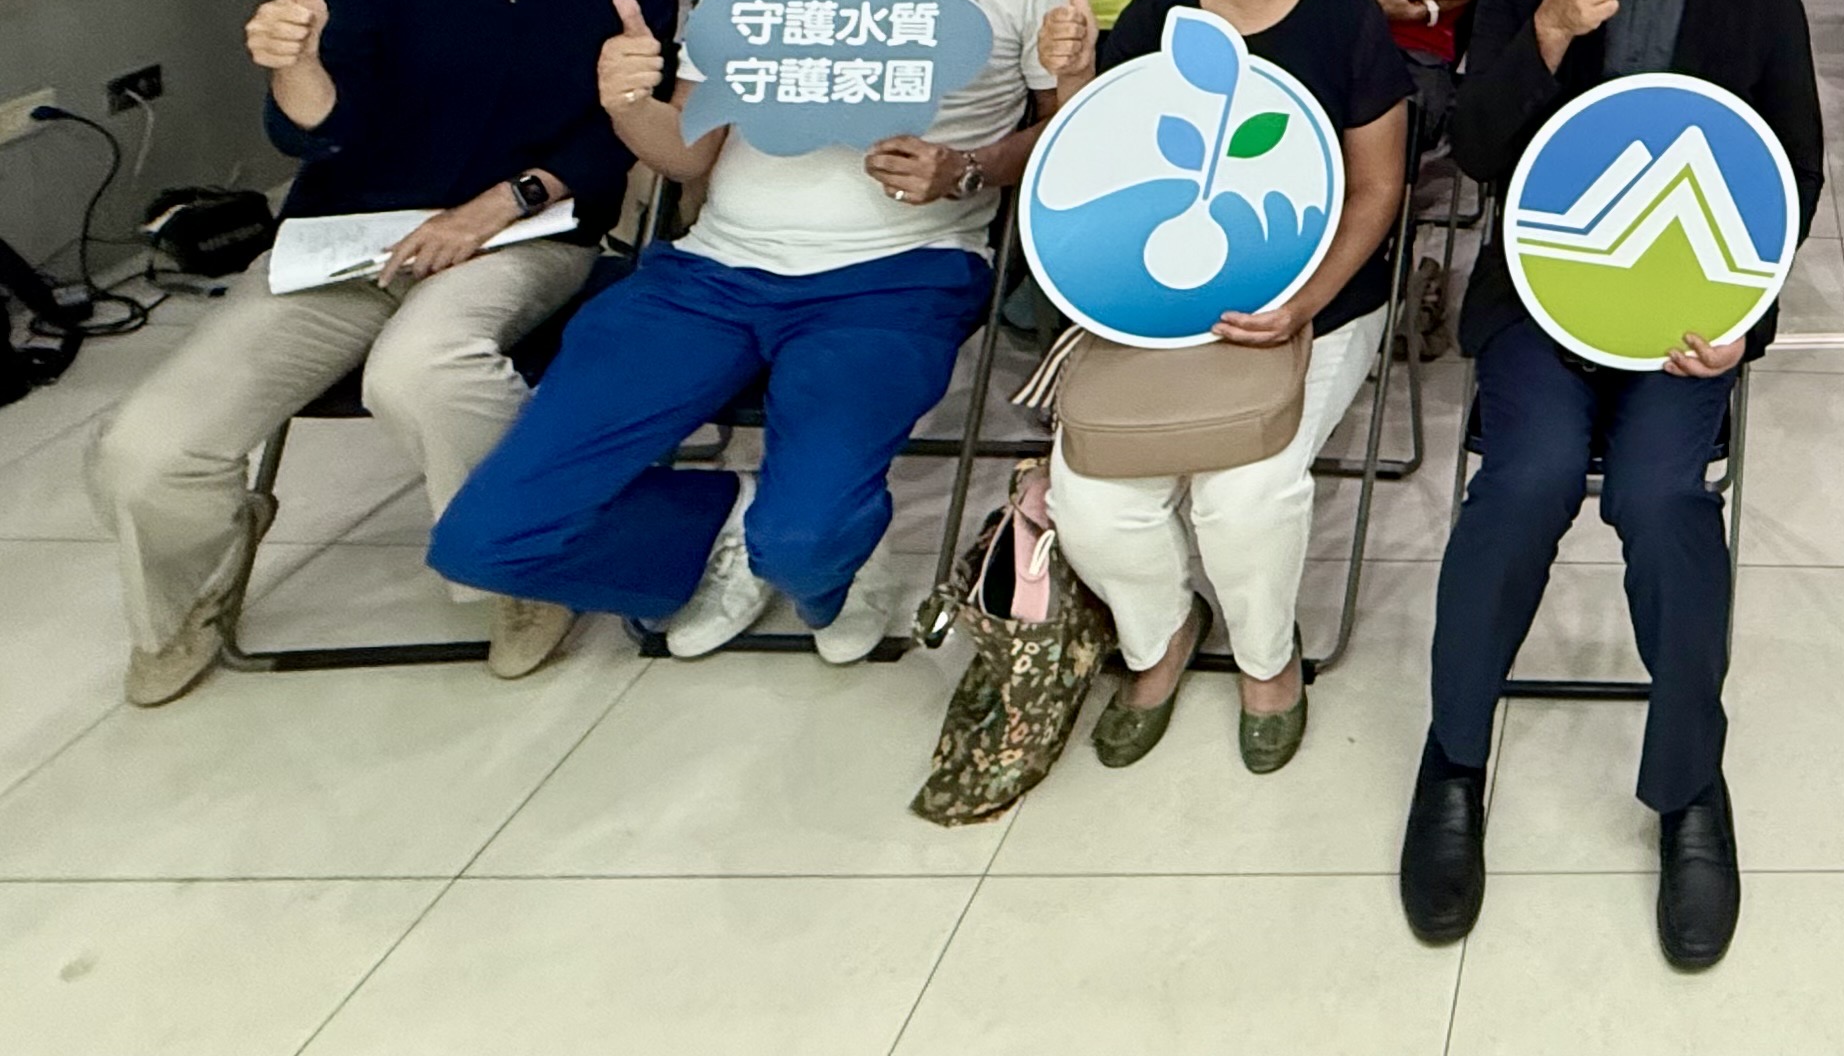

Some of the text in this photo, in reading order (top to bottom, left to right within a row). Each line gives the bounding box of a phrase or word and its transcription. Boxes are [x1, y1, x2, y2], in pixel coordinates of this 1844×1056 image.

[731, 0, 939, 47] 守護水質
[725, 57, 934, 103] 守護家園
